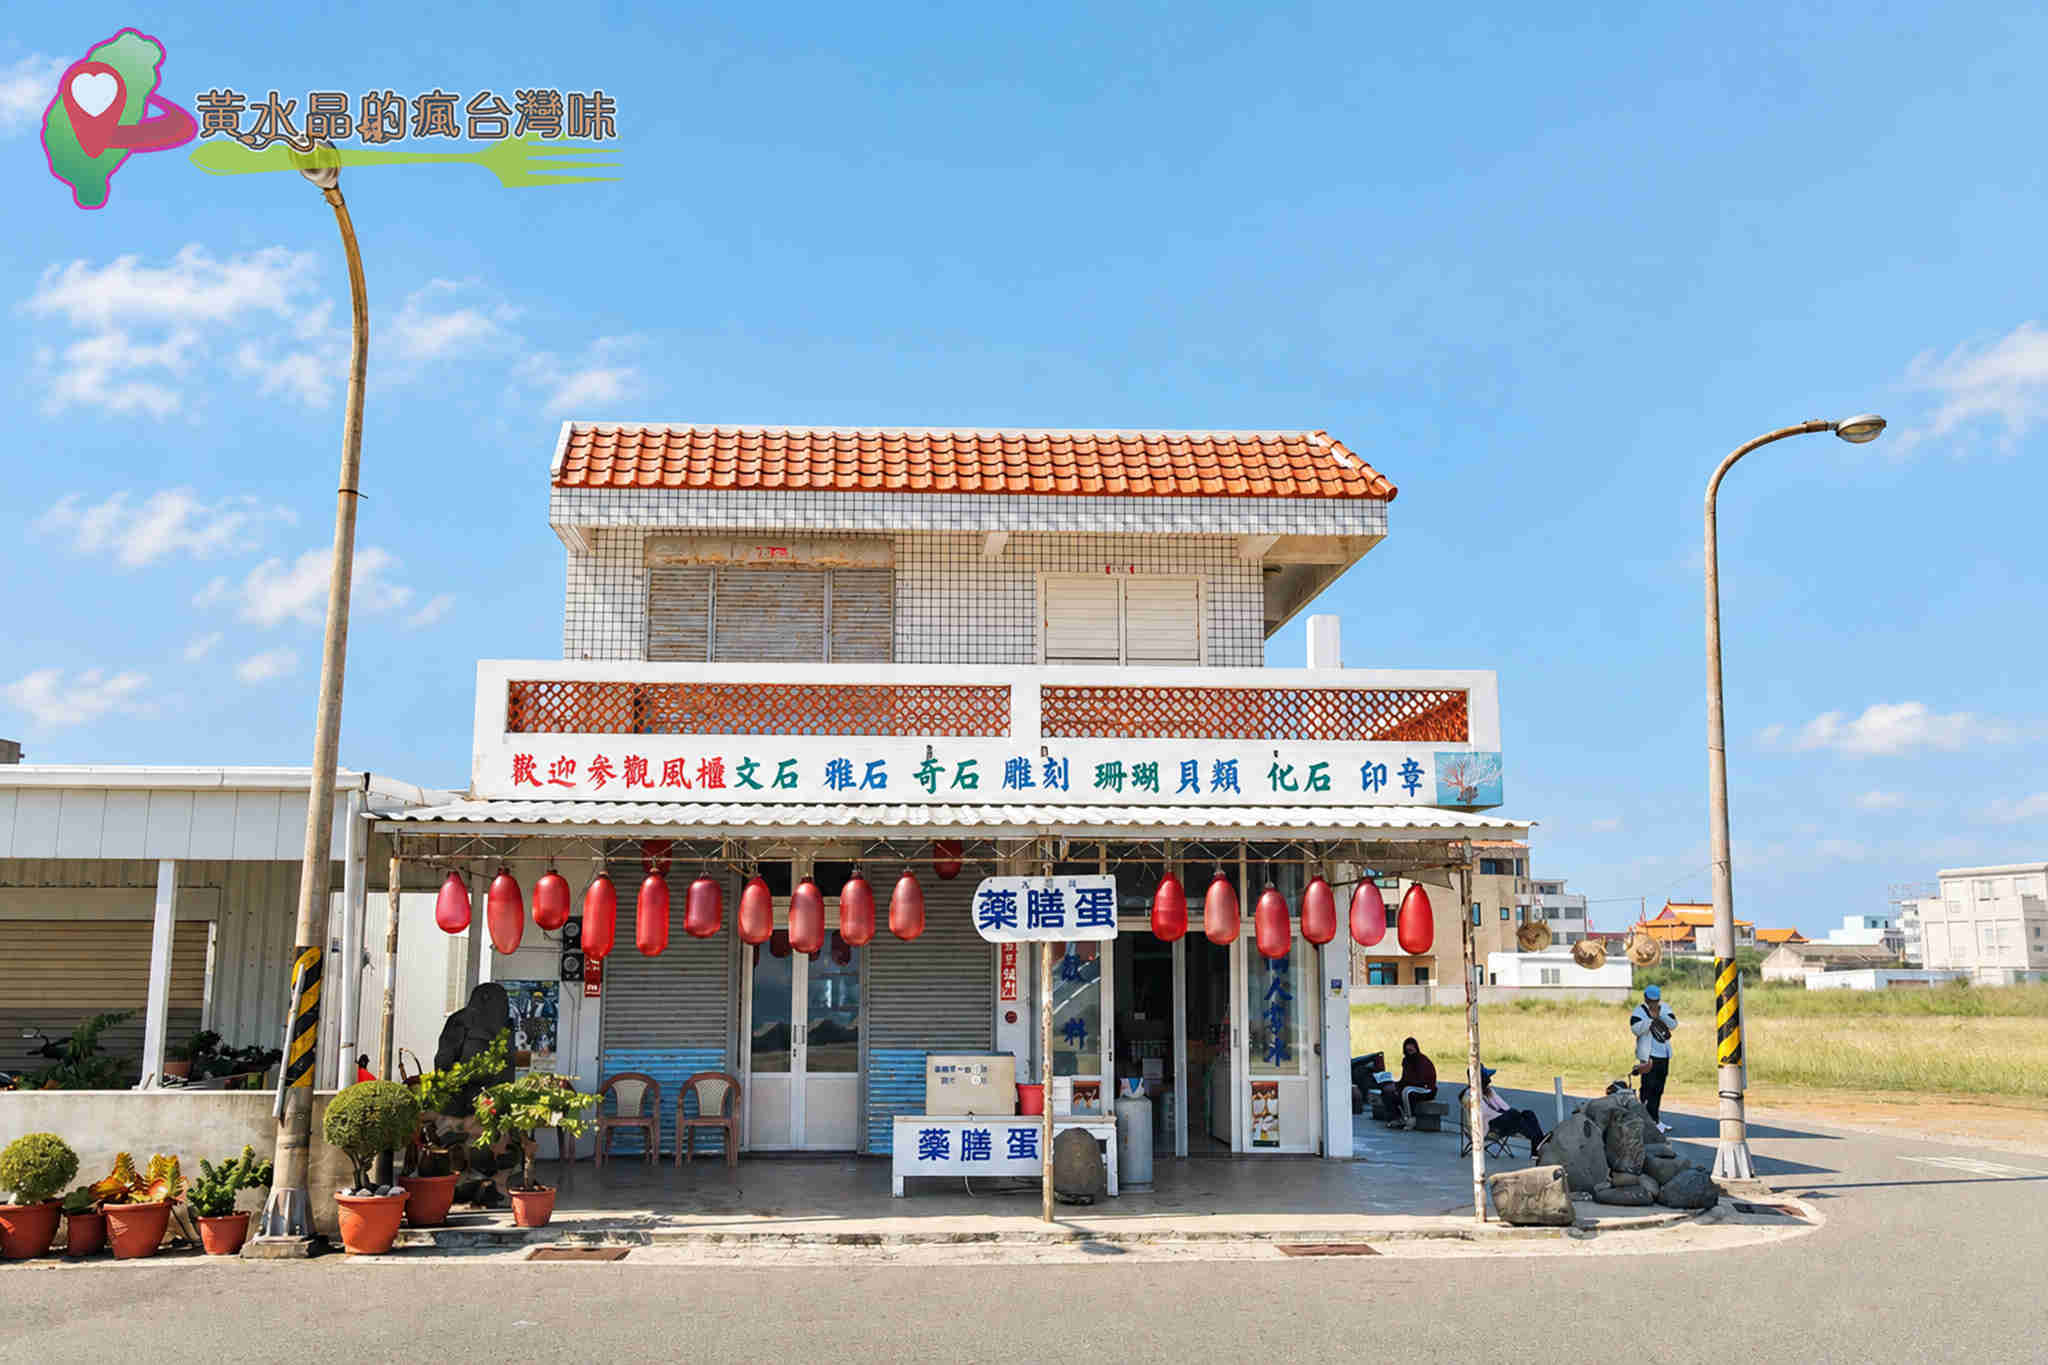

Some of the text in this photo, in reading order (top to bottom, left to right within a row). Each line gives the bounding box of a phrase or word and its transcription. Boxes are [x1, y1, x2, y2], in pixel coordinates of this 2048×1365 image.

[735, 756, 799, 791] 文石
[824, 758, 889, 792] 雅石
[912, 756, 981, 793] 奇石
[1002, 756, 1070, 793] 雕刻
[1093, 760, 1160, 792] 珊瑚
[1175, 758, 1241, 795] 貝類
[1266, 761, 1331, 793] 化石
[1360, 757, 1425, 797] 印章
[978, 888, 1115, 929] 藥膳蛋
[918, 1128, 1038, 1161] 藥膳蛋
